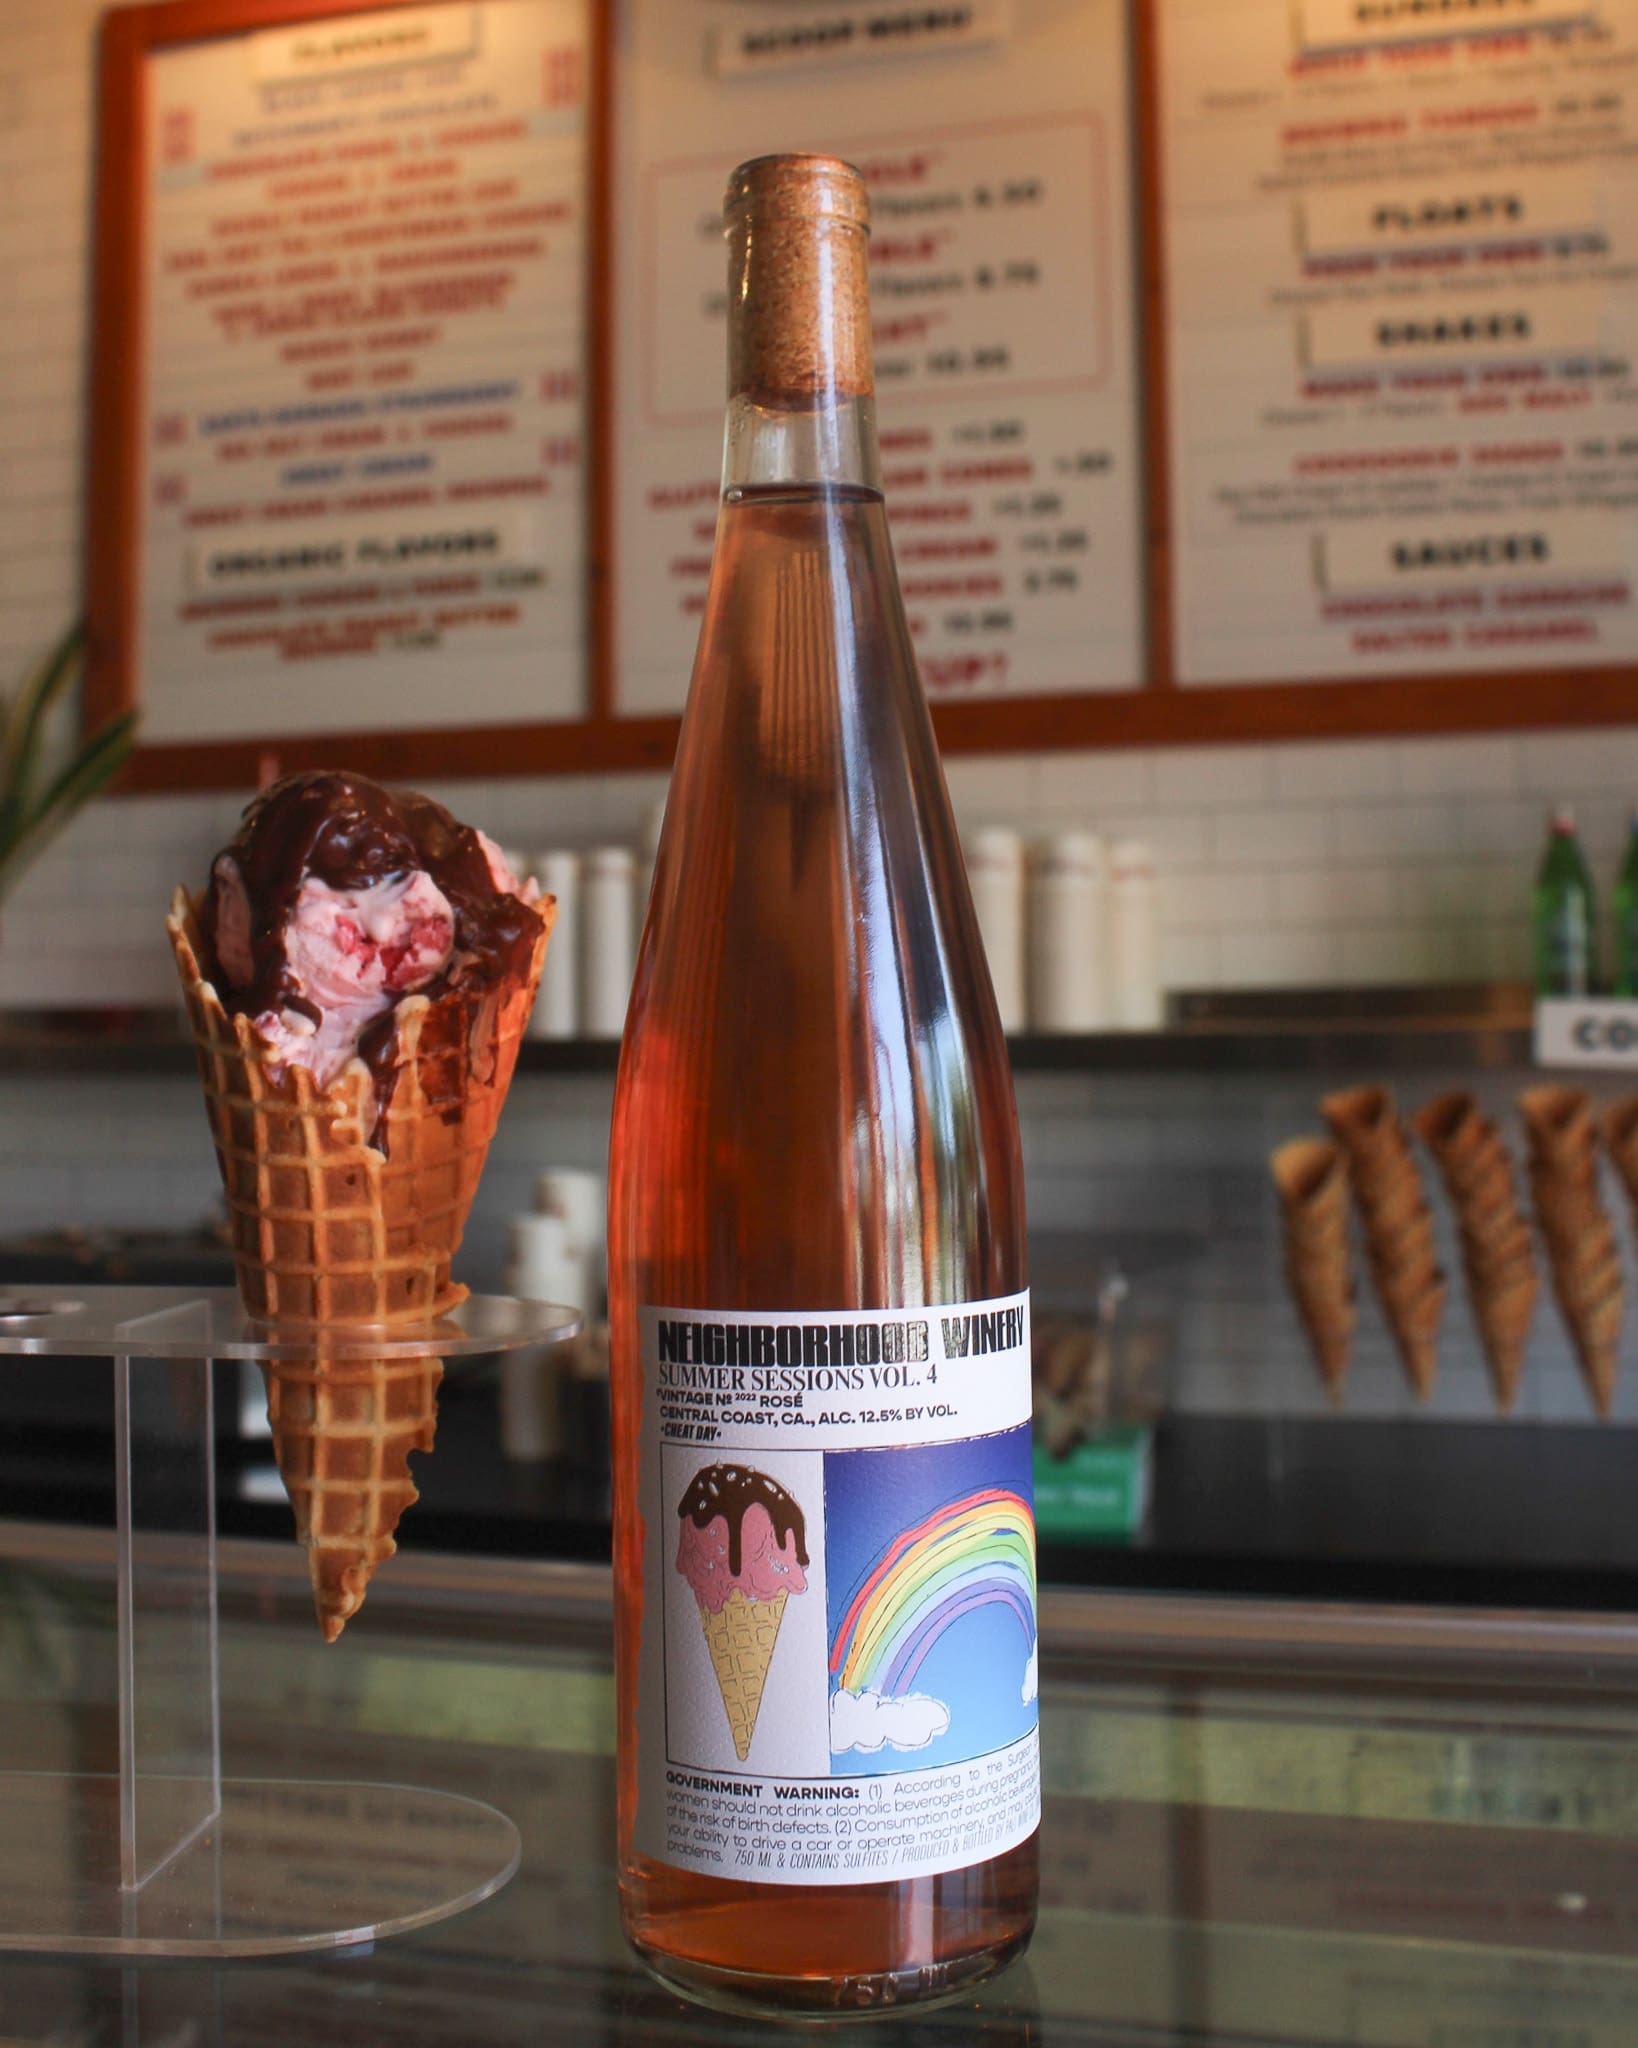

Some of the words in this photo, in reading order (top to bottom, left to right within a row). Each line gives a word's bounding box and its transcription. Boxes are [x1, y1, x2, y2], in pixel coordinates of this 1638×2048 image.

[1392, 532, 1548, 570] SAUCES
[658, 1319, 929, 1367] NEIGHBORHOOD
[941, 1305, 1024, 1360] WINERY
[658, 1364, 746, 1390] SUMMER
[751, 1367, 864, 1391] SESSIONS
[869, 1365, 921, 1390] VOL.
[926, 1363, 938, 1385] 4
[760, 1391, 804, 1409] ROSÉ
[659, 1405, 719, 1424] CENTRAL
[721, 1410, 779, 1428] COAST,
[781, 1412, 816, 1428] CA.,
[818, 1411, 856, 1425] ALC.
[859, 1409, 903, 1423] 12.5%
[905, 1406, 924, 1421] BY
[927, 1403, 958, 1418] VOL.
[666, 1770, 763, 1798] GOVERNMENT
[773, 1785, 860, 1799] WARNING:
[868, 1783, 883, 1800] (1)
[893, 1773, 961, 1796] According
[969, 1768, 981, 1782] to
[666, 1789, 710, 1809] women
[711, 1796, 757, 1815] should
[759, 1803, 783, 1817] not
[786, 1803, 823, 1817] drink
[825, 1801, 891, 1817] alcoholic
[895, 1790, 965, 1812] beverages
[666, 1804, 678, 1817] of
[679, 1806, 699, 1823] the
[700, 1812, 720, 1827] risk
[721, 1815, 736, 1829] of
[738, 1817, 770, 1833] birth
[772, 1820, 832, 1835] defects.
[834, 1818, 852, 1837] (2)
[854, 1810, 949, 1833] Consumption
[951, 1804, 963, 1820] of
[666, 1823, 690, 1837] your
[693, 1827, 730, 1848] ability
[733, 1834, 747, 1848] to
[751, 1835, 786, 1851] drive
[791, 1840, 802, 1852] a
[806, 1840, 832, 1852] car
[837, 1840, 852, 1852] or
[857, 1833, 915, 1852] operate
[667, 1840, 724, 1863] problems.
[734, 1849, 755, 1867] 750
[758, 1851, 772, 1869] ML
[776, 1852, 786, 1869] &
[789, 1852, 840, 1870] CONTAINS
[843, 1849, 889, 1869] SULFITES
[901, 1839, 950, 1864] PRODUCED
